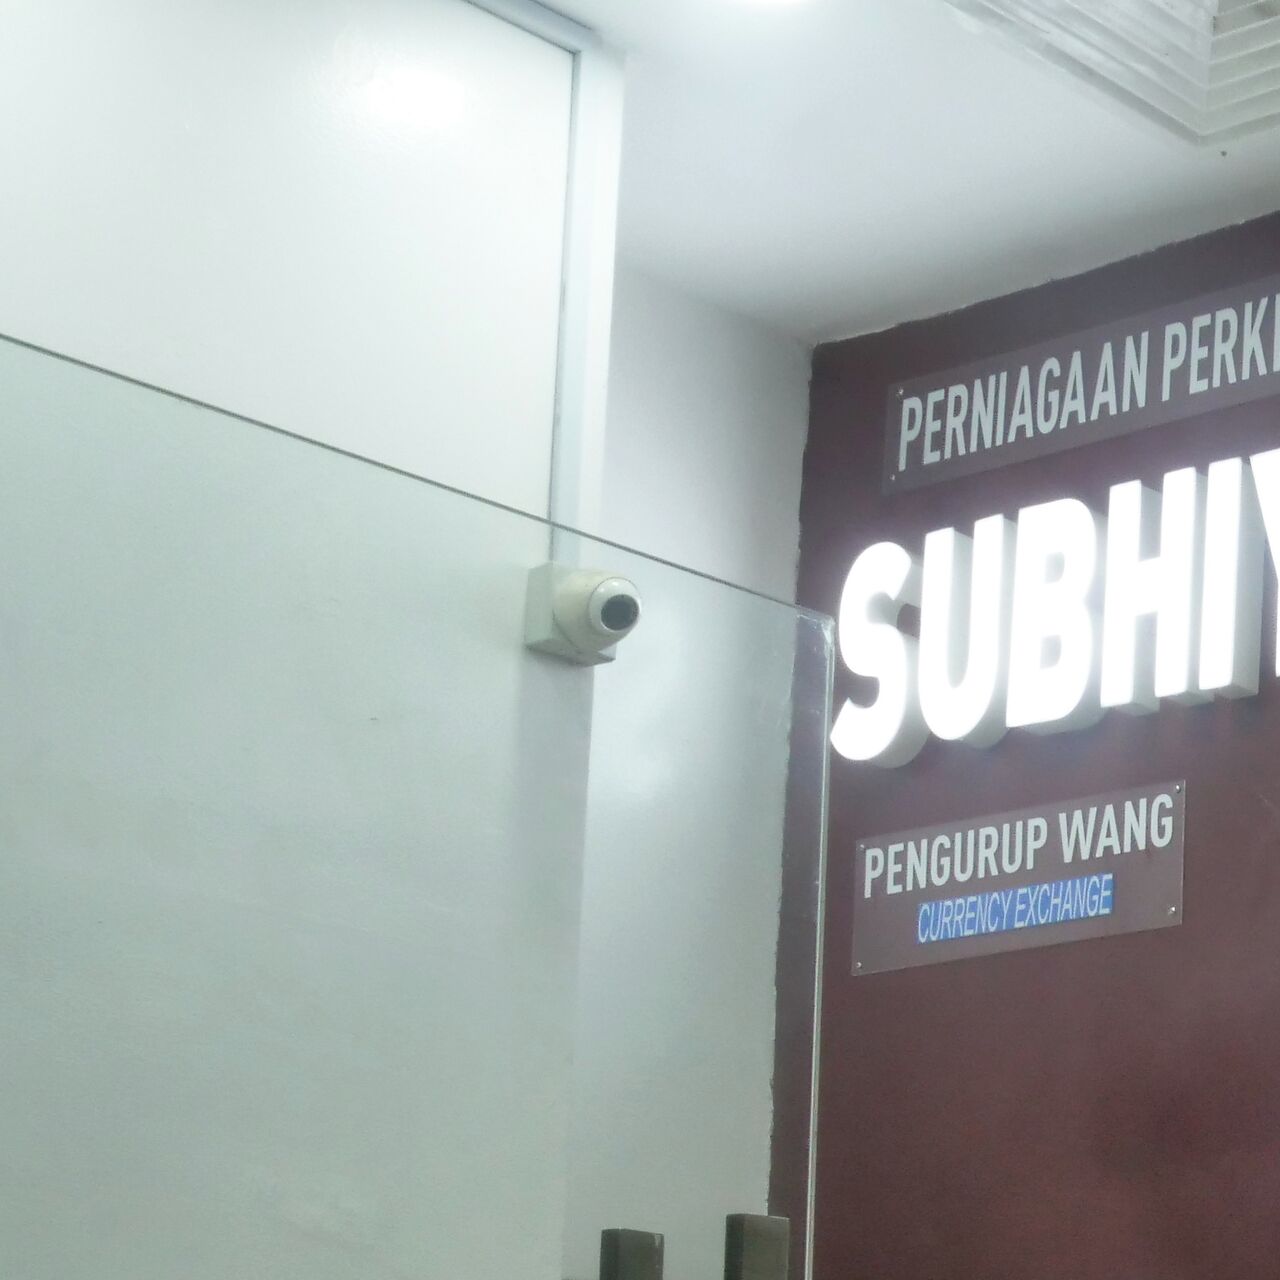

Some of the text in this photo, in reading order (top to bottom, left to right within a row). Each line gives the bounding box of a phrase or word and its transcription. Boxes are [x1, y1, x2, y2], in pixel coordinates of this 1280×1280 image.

[898, 329, 1148, 473] PERNIAGAAN
[863, 793, 1175, 898] PENGURUP WANG
[918, 873, 1113, 943] CURRENCY EXCHANGE
